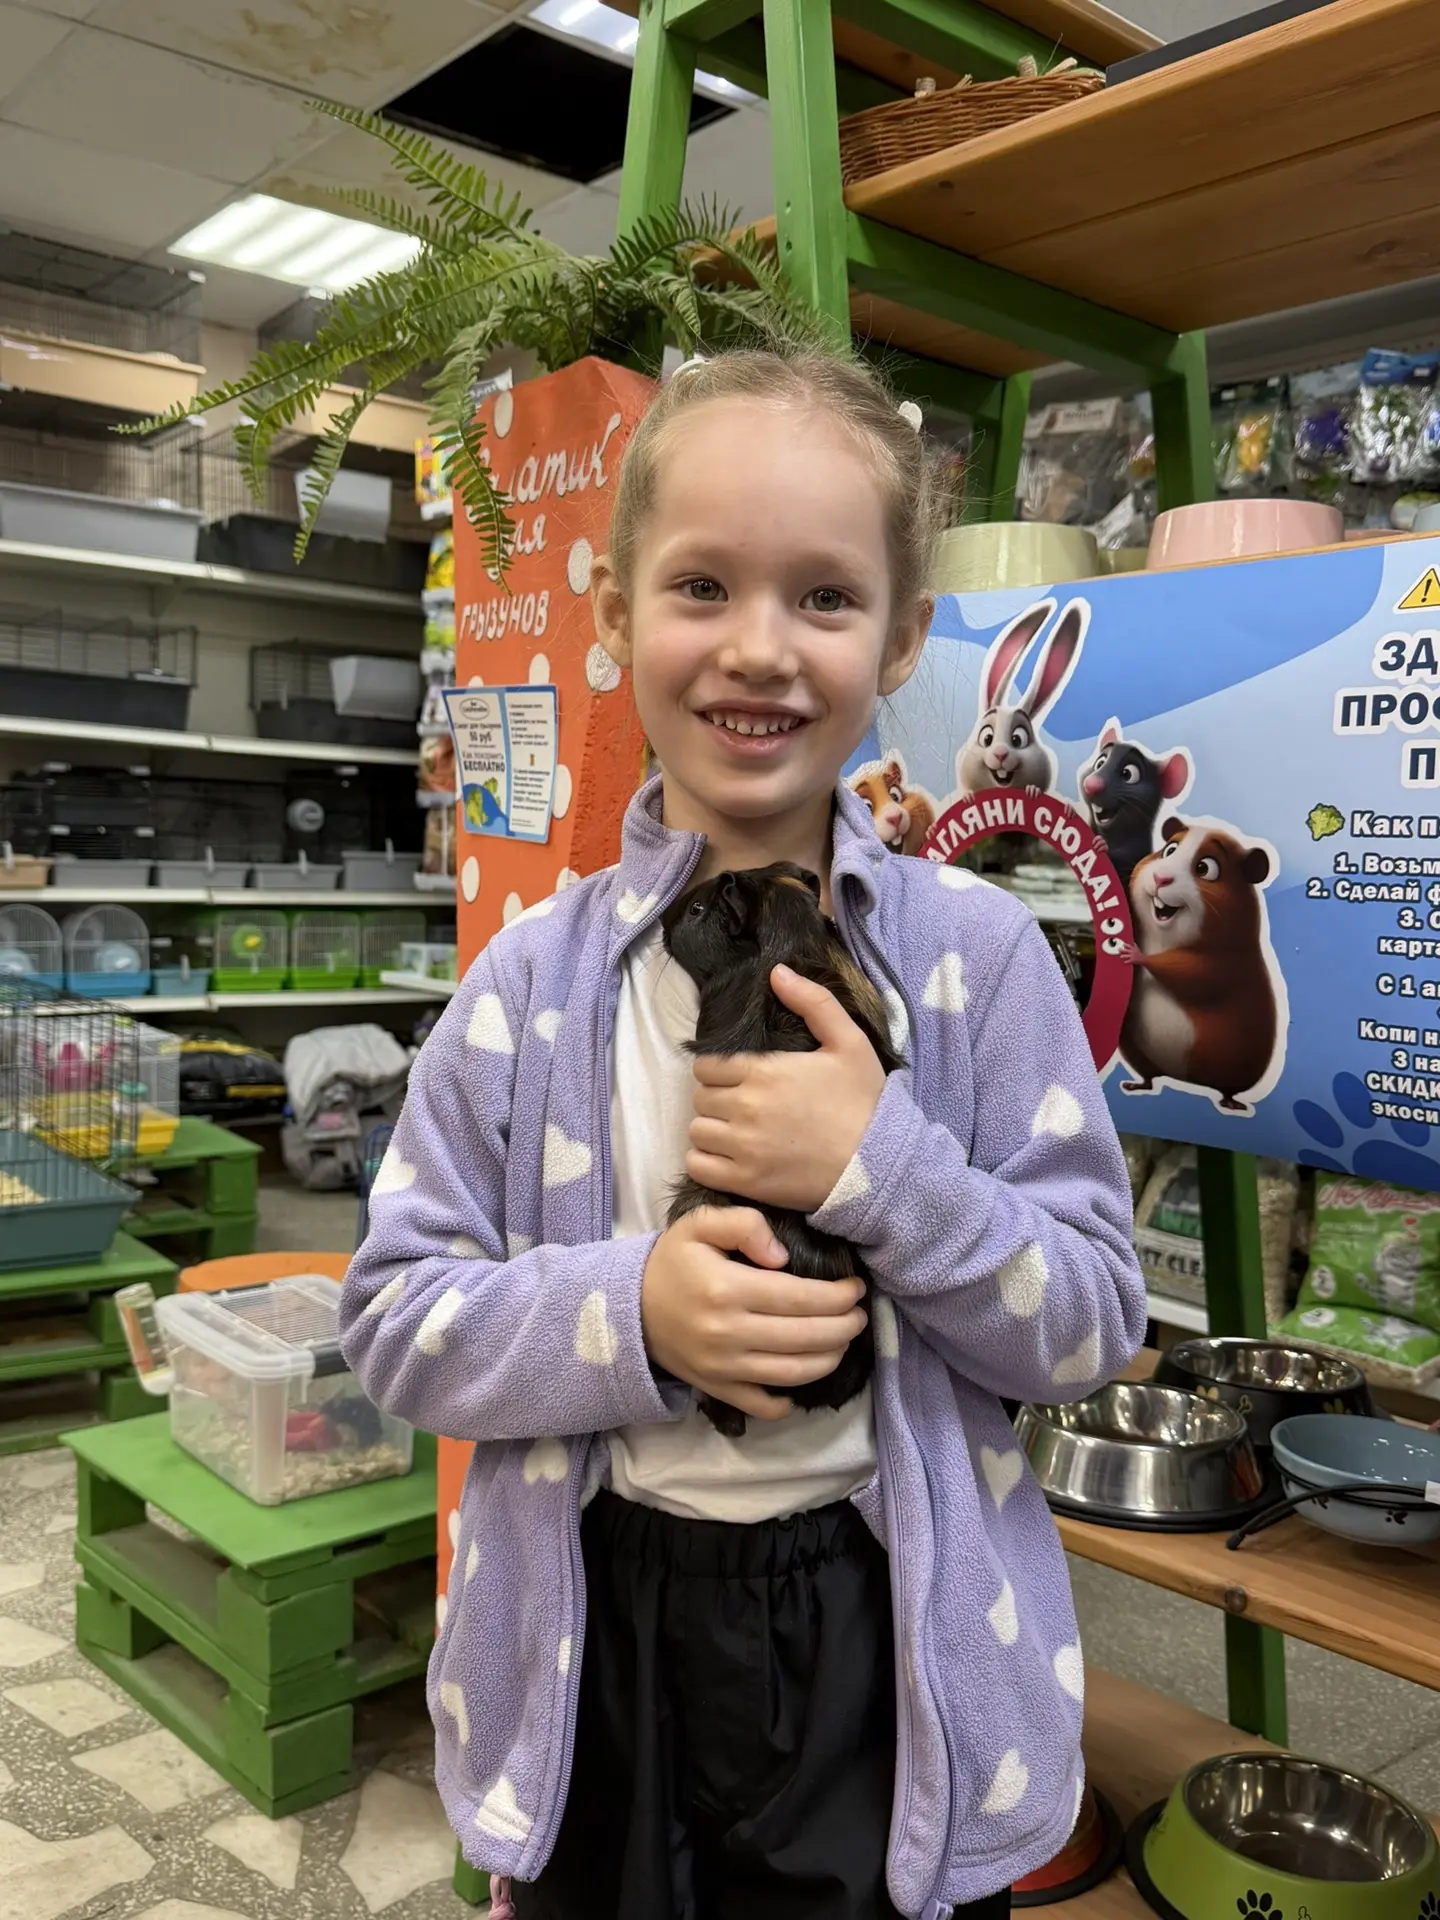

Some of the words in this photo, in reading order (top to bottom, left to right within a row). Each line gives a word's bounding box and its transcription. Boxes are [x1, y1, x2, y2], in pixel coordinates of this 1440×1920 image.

[1340, 691, 1440, 728] ПРО
[463, 760, 505, 773] БЕСПЛАТНО
[1352, 812, 1412, 836] Как
[1033, 806, 1119, 913] СЮДА!
[1335, 854, 1358, 873] 1.
[1307, 879, 1329, 898] 2.
[1335, 879, 1420, 901] Сделай
[1399, 909, 1422, 928] 3.
[1378, 975, 1394, 994] С
[1401, 977, 1415, 996] 1
[1421, 982, 1440, 998] а
[1360, 1020, 1417, 1044] Копи
[1393, 1050, 1408, 1068] 3
[1366, 1072, 1440, 1100] СКИДК
[1371, 1101, 1439, 1124] экоси
